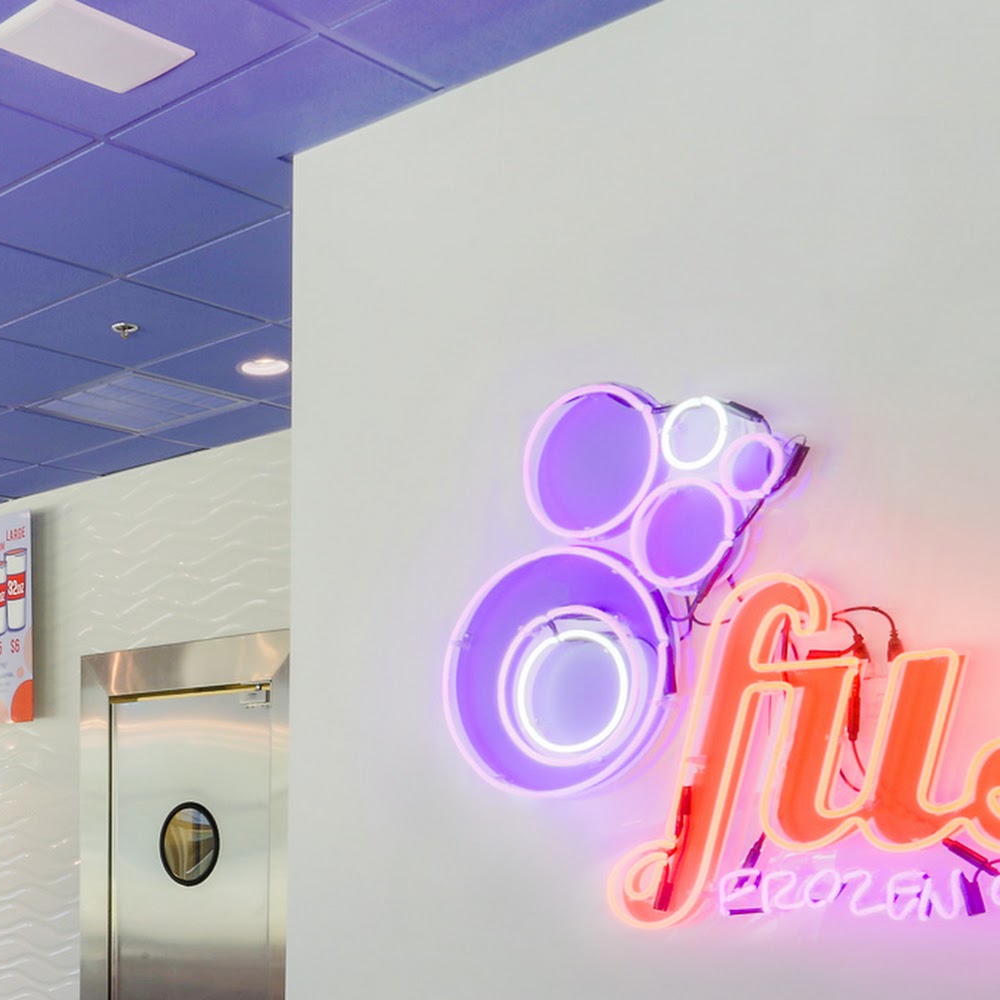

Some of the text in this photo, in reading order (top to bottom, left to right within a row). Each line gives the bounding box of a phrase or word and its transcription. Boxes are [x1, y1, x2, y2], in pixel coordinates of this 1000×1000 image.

[5, 526, 26, 541] LARGE
[7, 579, 24, 595] 32oz
[607, 572, 1000, 930] fu
[719, 867, 963, 922] FROZEN
